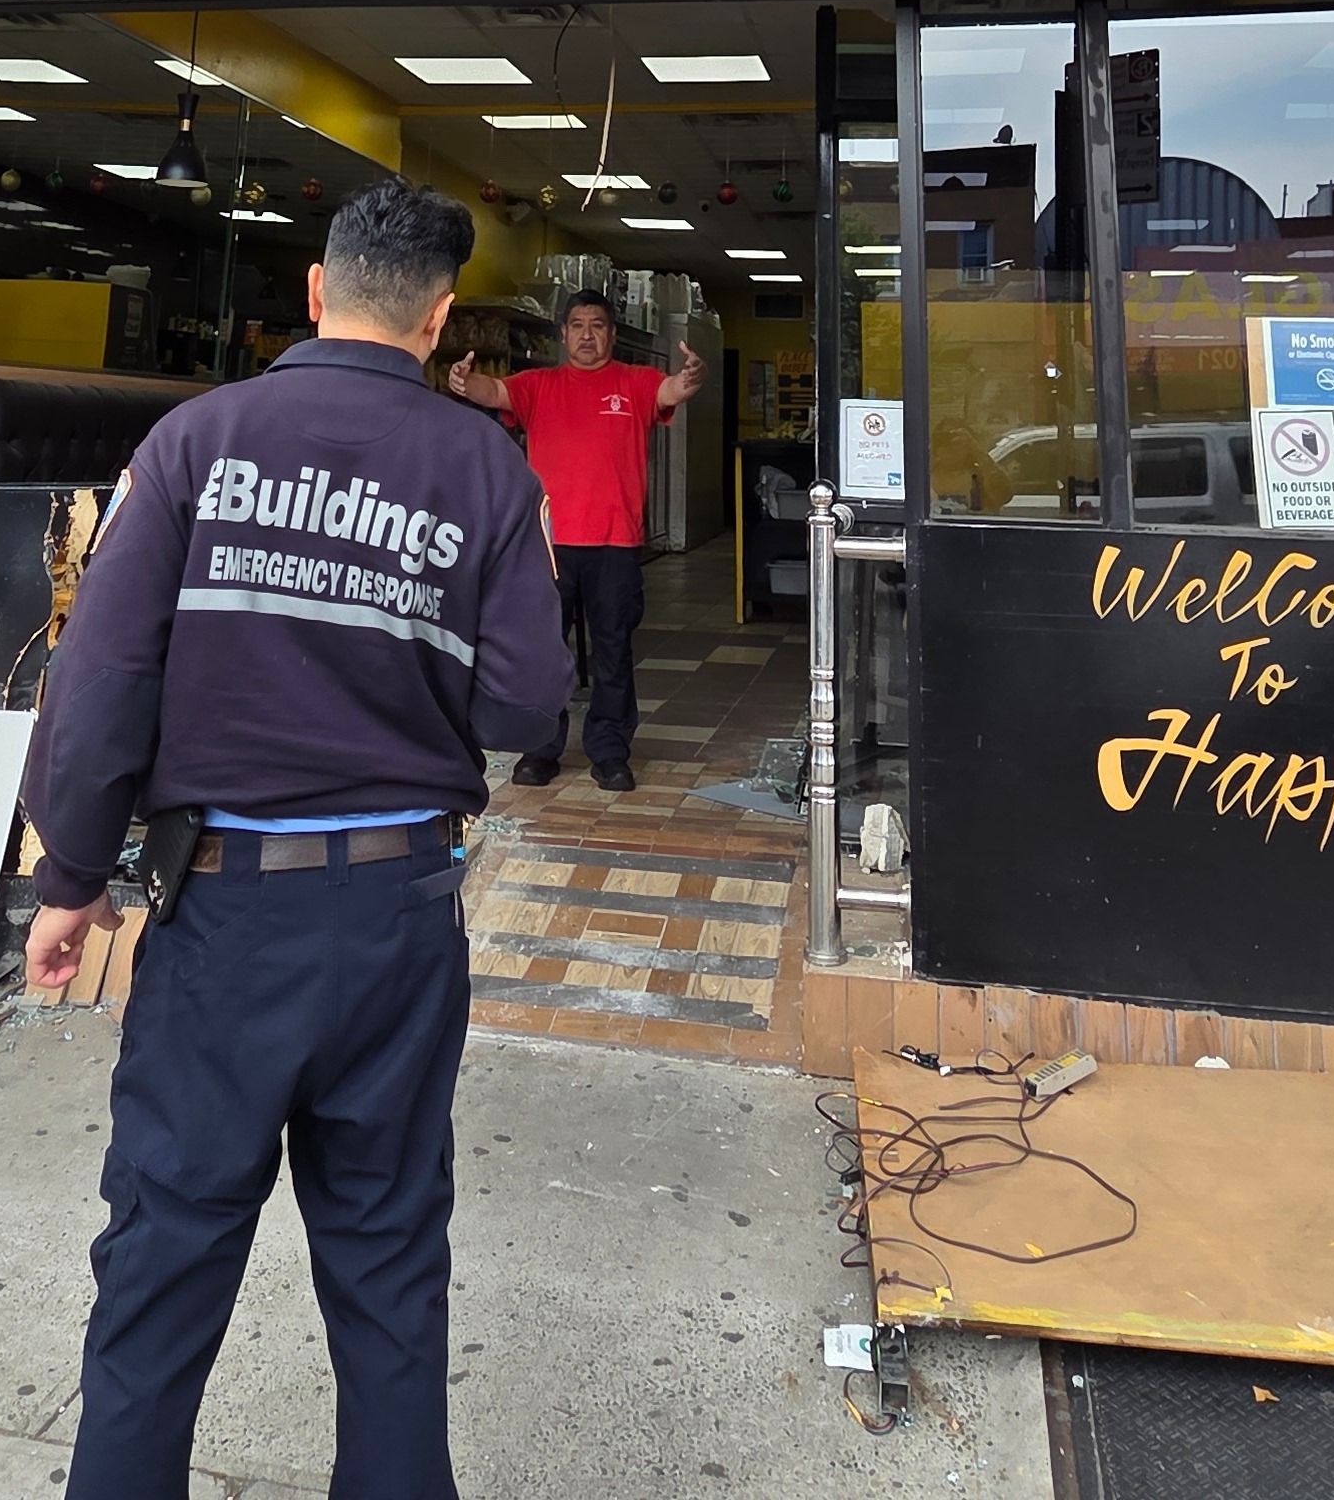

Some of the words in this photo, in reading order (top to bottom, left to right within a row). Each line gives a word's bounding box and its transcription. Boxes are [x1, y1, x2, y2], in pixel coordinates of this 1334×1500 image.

[1291, 333, 1307, 349] No
[1272, 483, 1288, 493] NO
[1283, 496, 1313, 507] FOOD
[1315, 495, 1332, 506] OR
[218, 457, 464, 575] Buildings
[208, 546, 344, 597] EMERGENCY
[344, 565, 445, 621] RESPONSE
[1219, 637, 1300, 706] To
